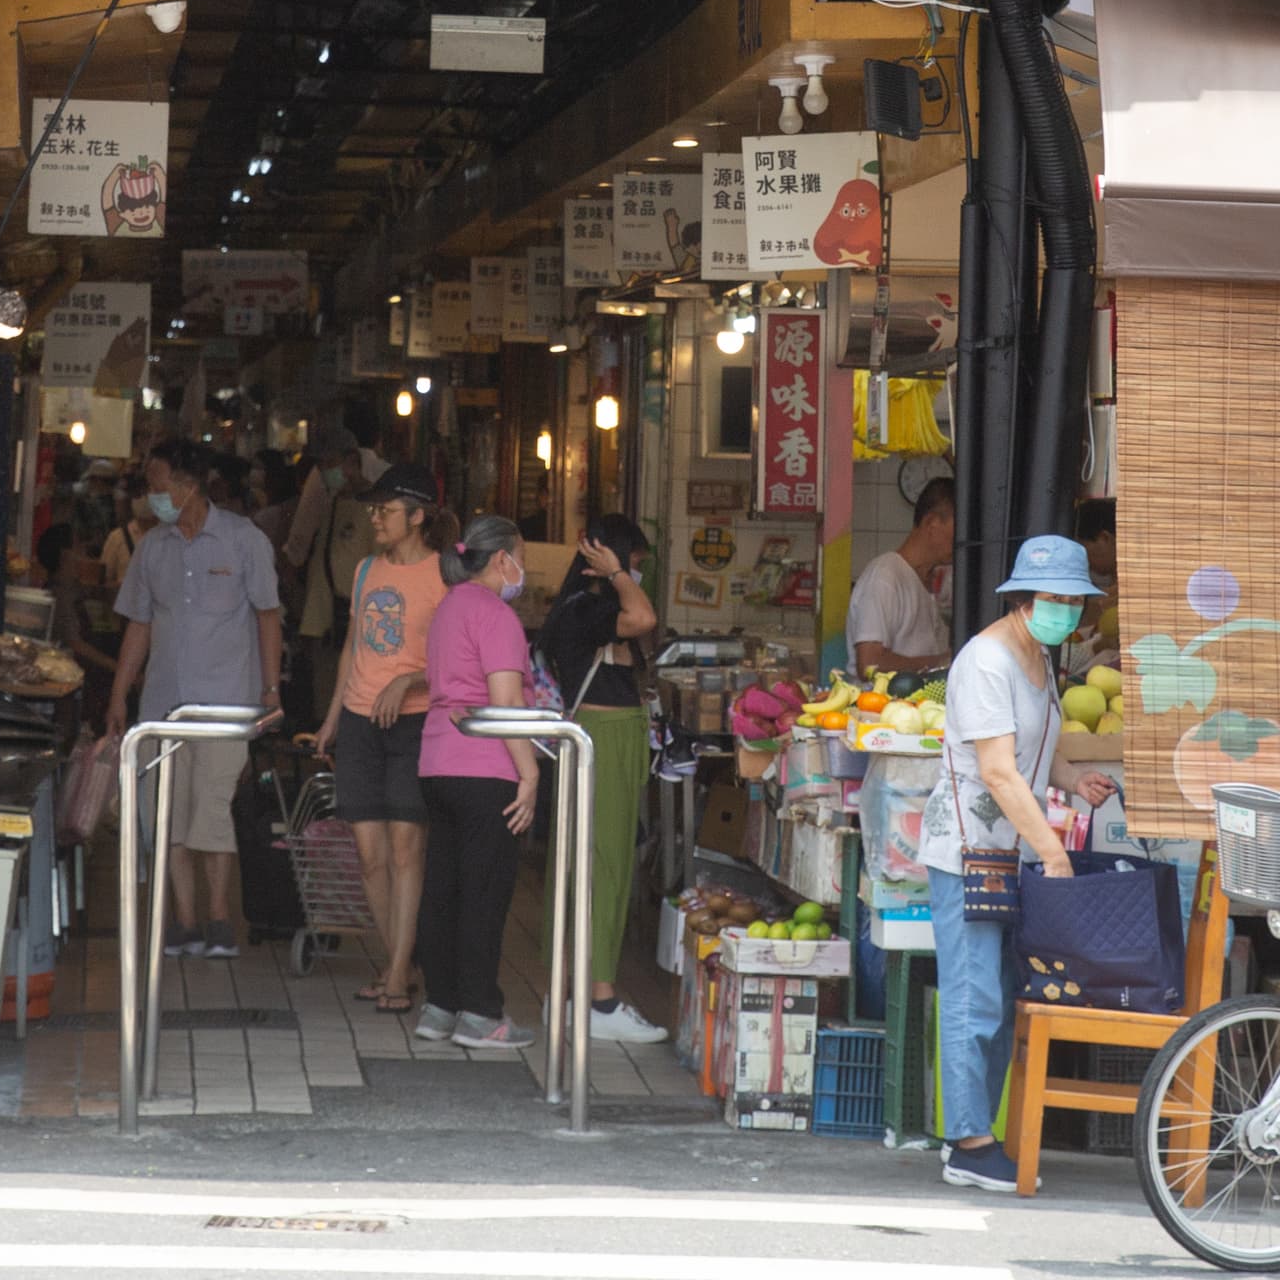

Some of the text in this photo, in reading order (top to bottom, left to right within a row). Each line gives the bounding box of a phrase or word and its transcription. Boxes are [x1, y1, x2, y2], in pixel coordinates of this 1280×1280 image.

[755, 149, 798, 171] 阿賢
[623, 179, 674, 197] 源味香
[756, 173, 822, 196] 水果攤
[623, 199, 657, 217] 食品
[771, 321, 817, 478] 源味香
[768, 481, 817, 507] 食品
